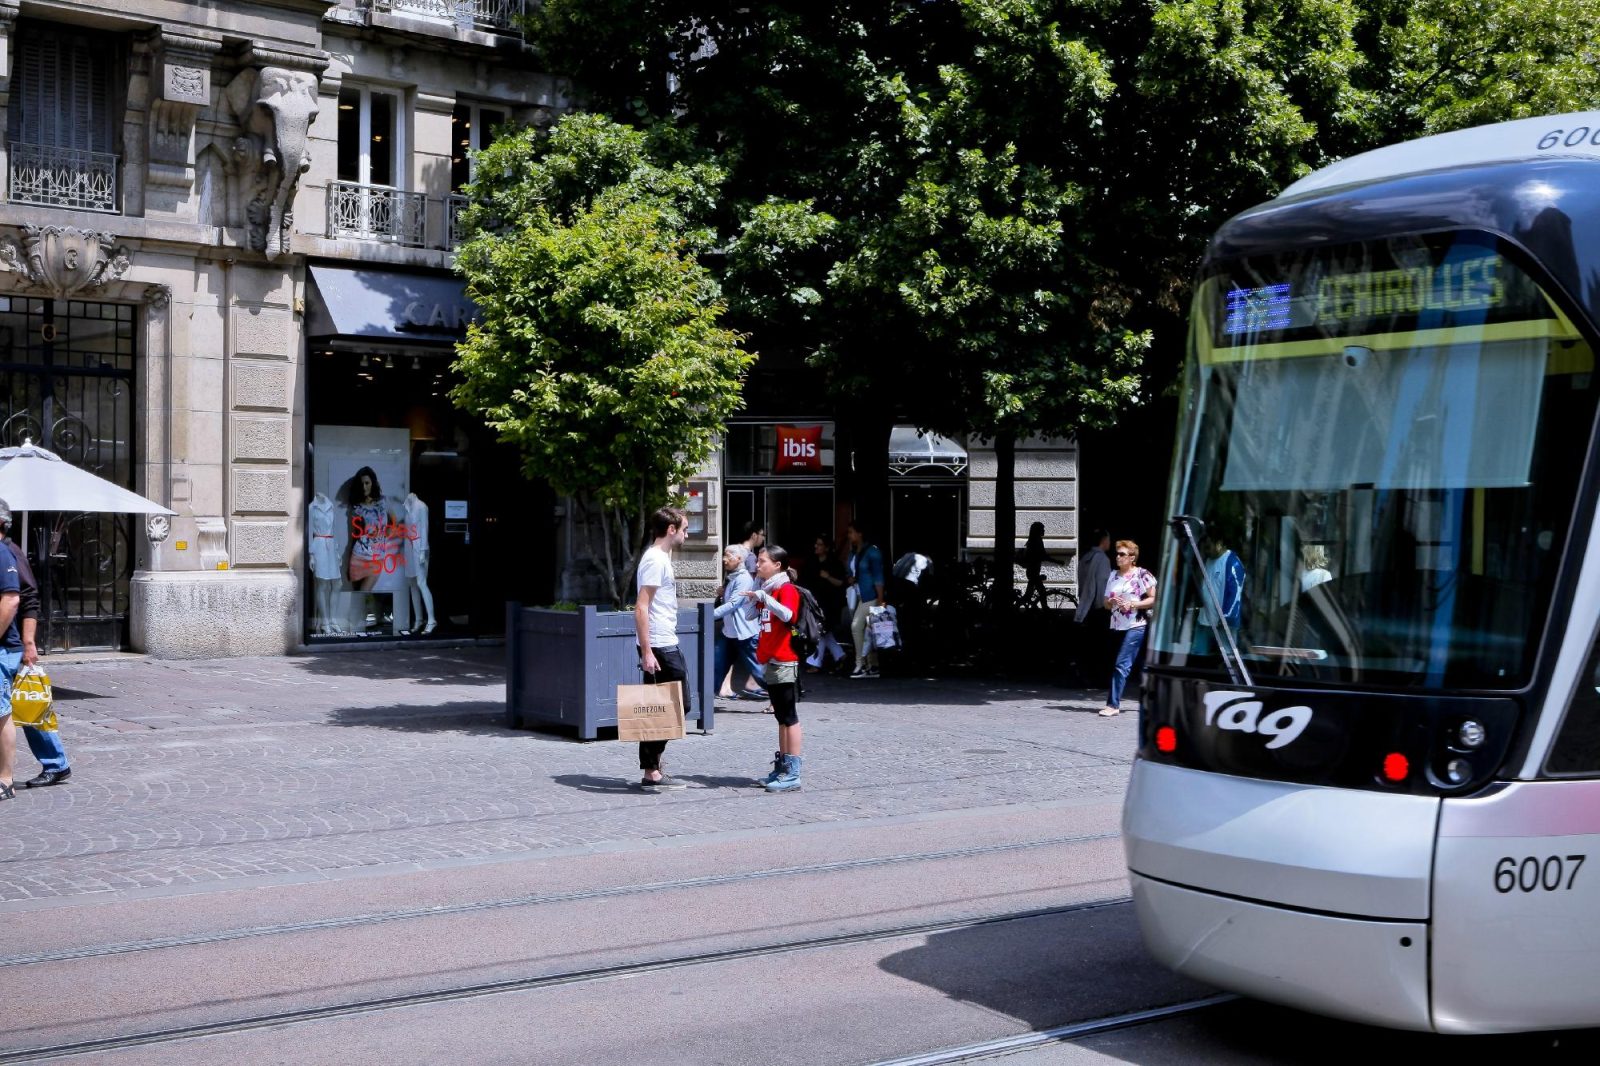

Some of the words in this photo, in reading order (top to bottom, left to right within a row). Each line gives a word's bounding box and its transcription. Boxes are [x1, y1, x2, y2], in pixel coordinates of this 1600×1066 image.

[1318, 254, 1504, 321] ECHIROLLES
[783, 438, 816, 457] ibis
[351, 515, 418, 540] Soldes
[1203, 690, 1313, 750] Tag
[1494, 854, 1587, 894] 6007
